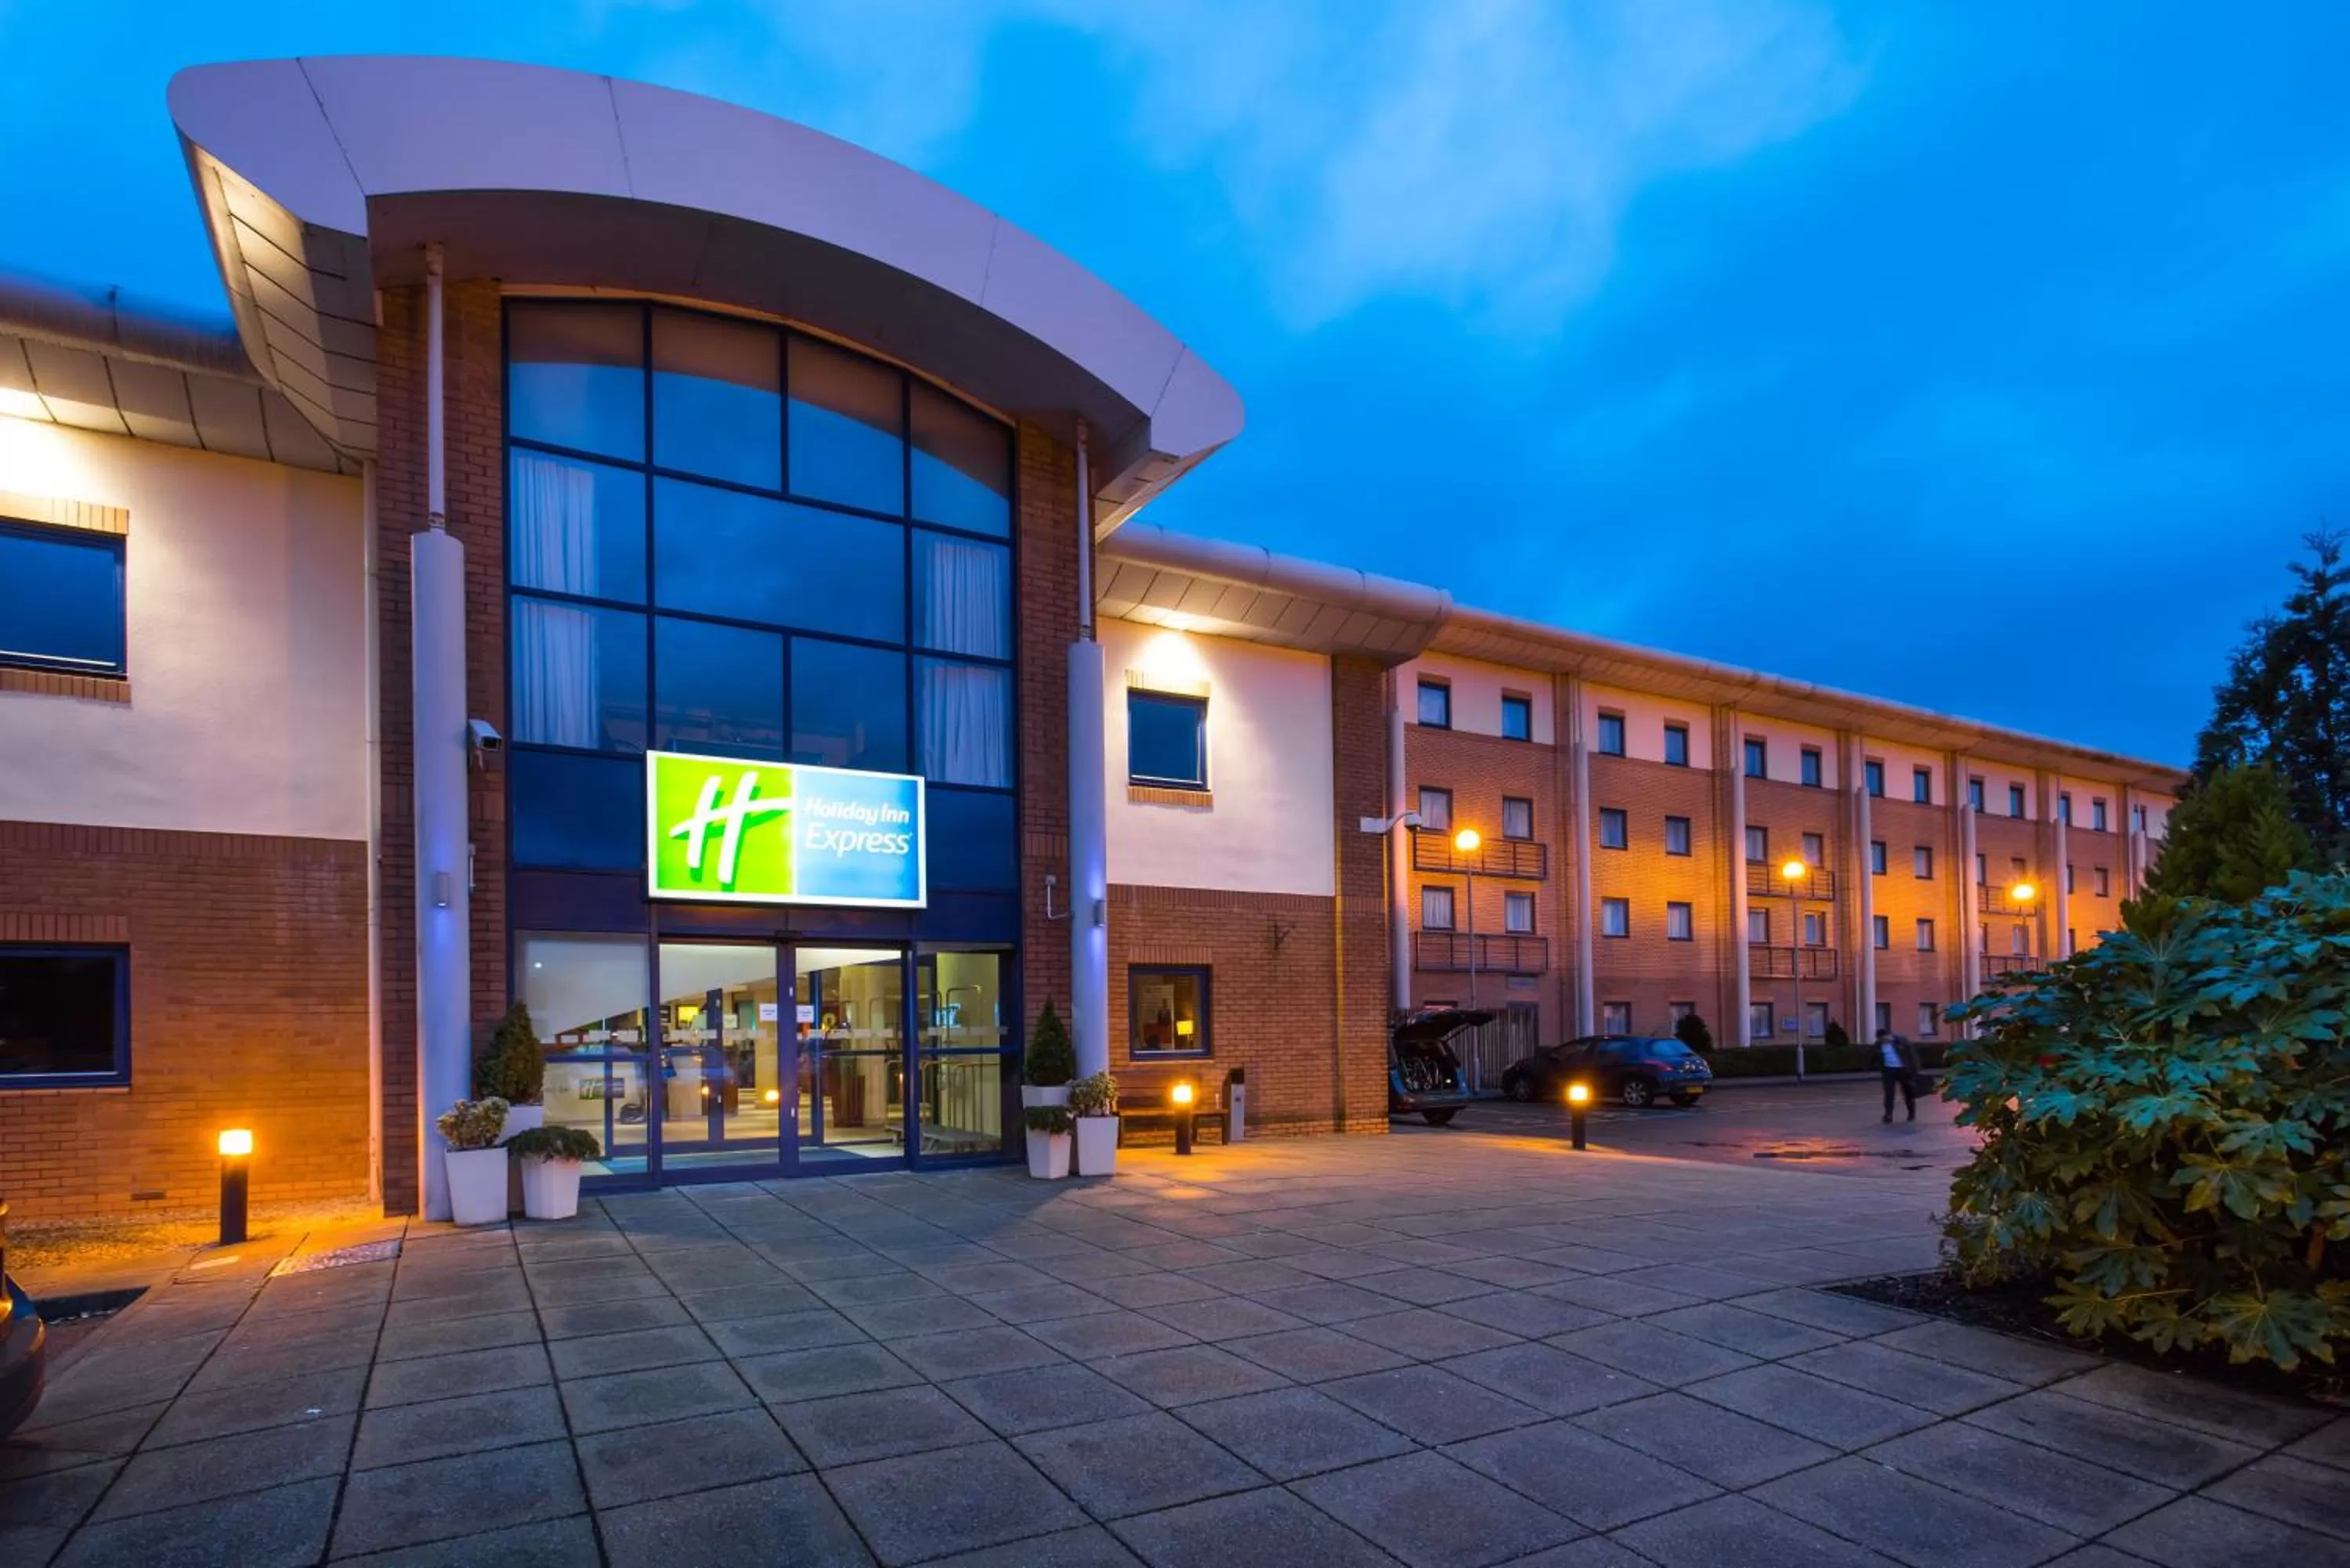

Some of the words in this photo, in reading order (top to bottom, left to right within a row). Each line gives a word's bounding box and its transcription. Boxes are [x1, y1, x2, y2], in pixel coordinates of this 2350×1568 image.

[805, 797, 878, 826] Holiday
[880, 803, 910, 824] Inn
[805, 822, 910, 859] Express
